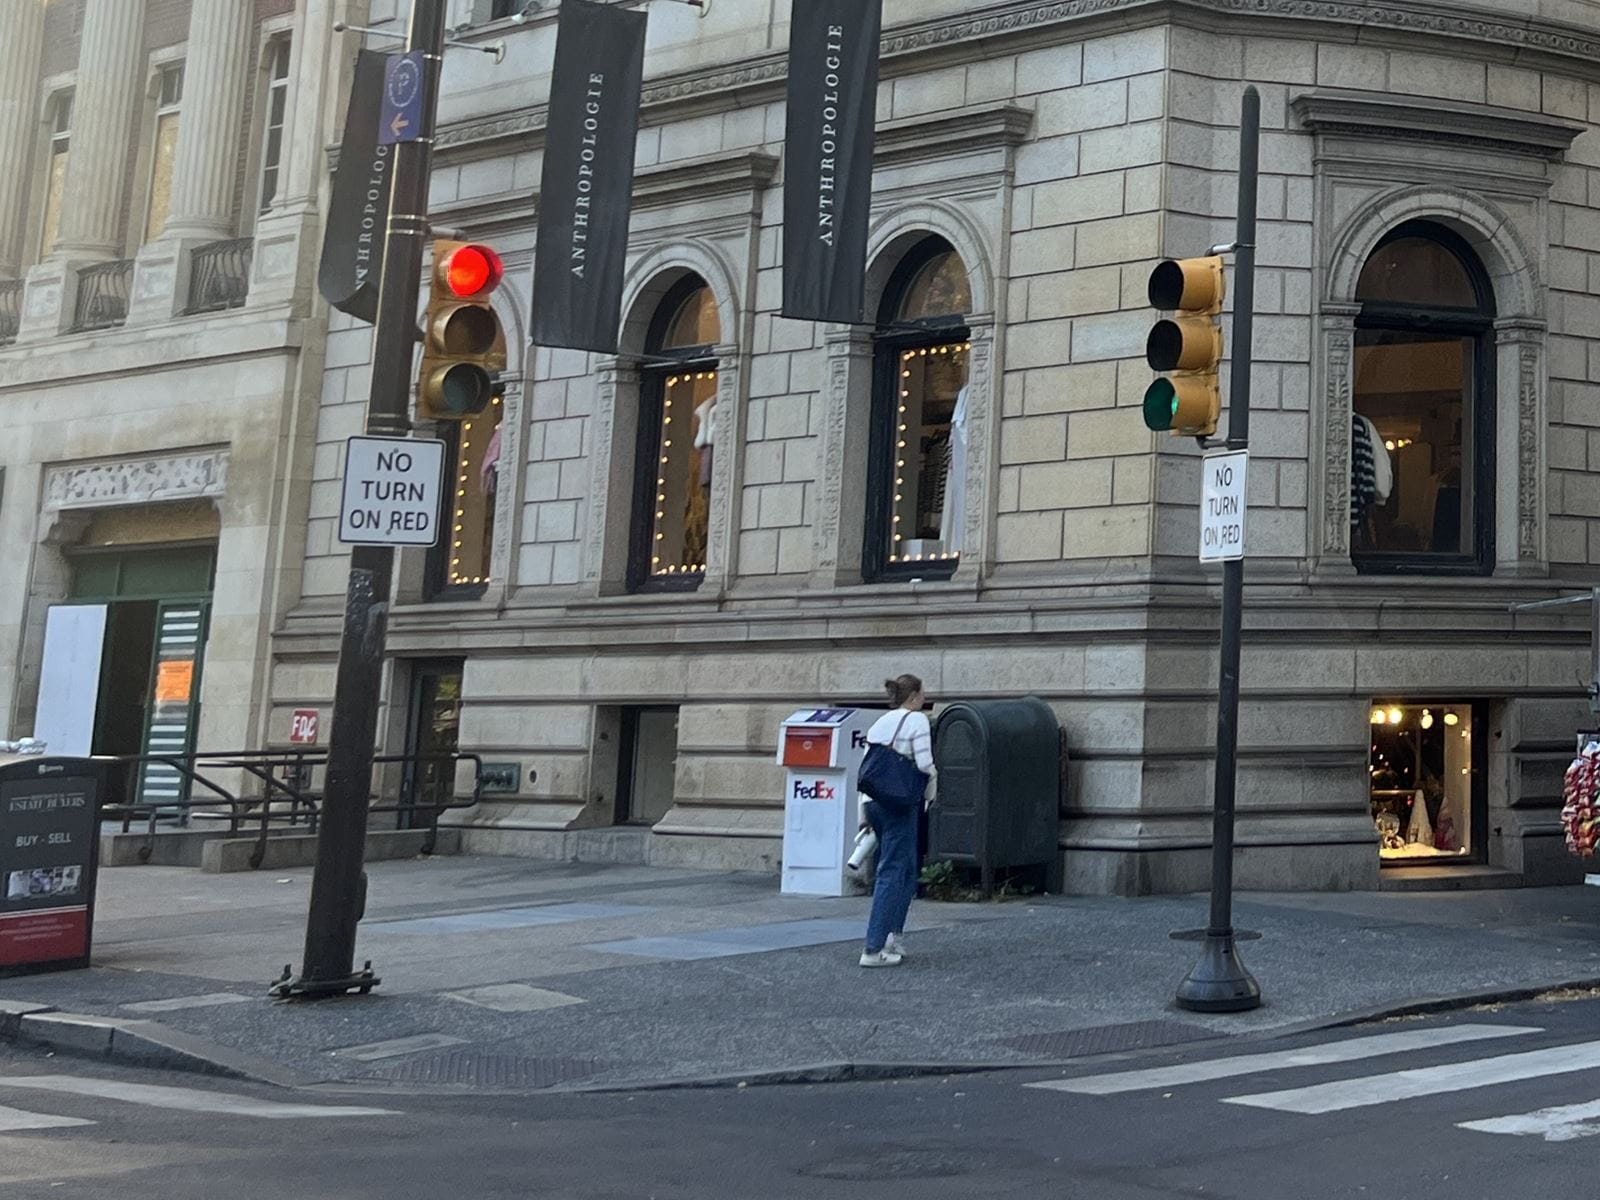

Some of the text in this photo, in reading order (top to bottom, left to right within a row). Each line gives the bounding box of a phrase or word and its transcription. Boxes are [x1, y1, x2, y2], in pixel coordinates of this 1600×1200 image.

[819, 25, 843, 247] ANTHROPOLOGIE
[571, 72, 604, 278] ANTHROPOLOGIE
[376, 451, 413, 473] NO
[1215, 467, 1233, 488] NO
[361, 480, 425, 502] TURN
[1208, 495, 1239, 517] TURN
[350, 509, 429, 531] ON RED
[1203, 524, 1240, 546] ON RED
[793, 780, 835, 799] FedEx
[16, 832, 72, 847] BUY SELL
